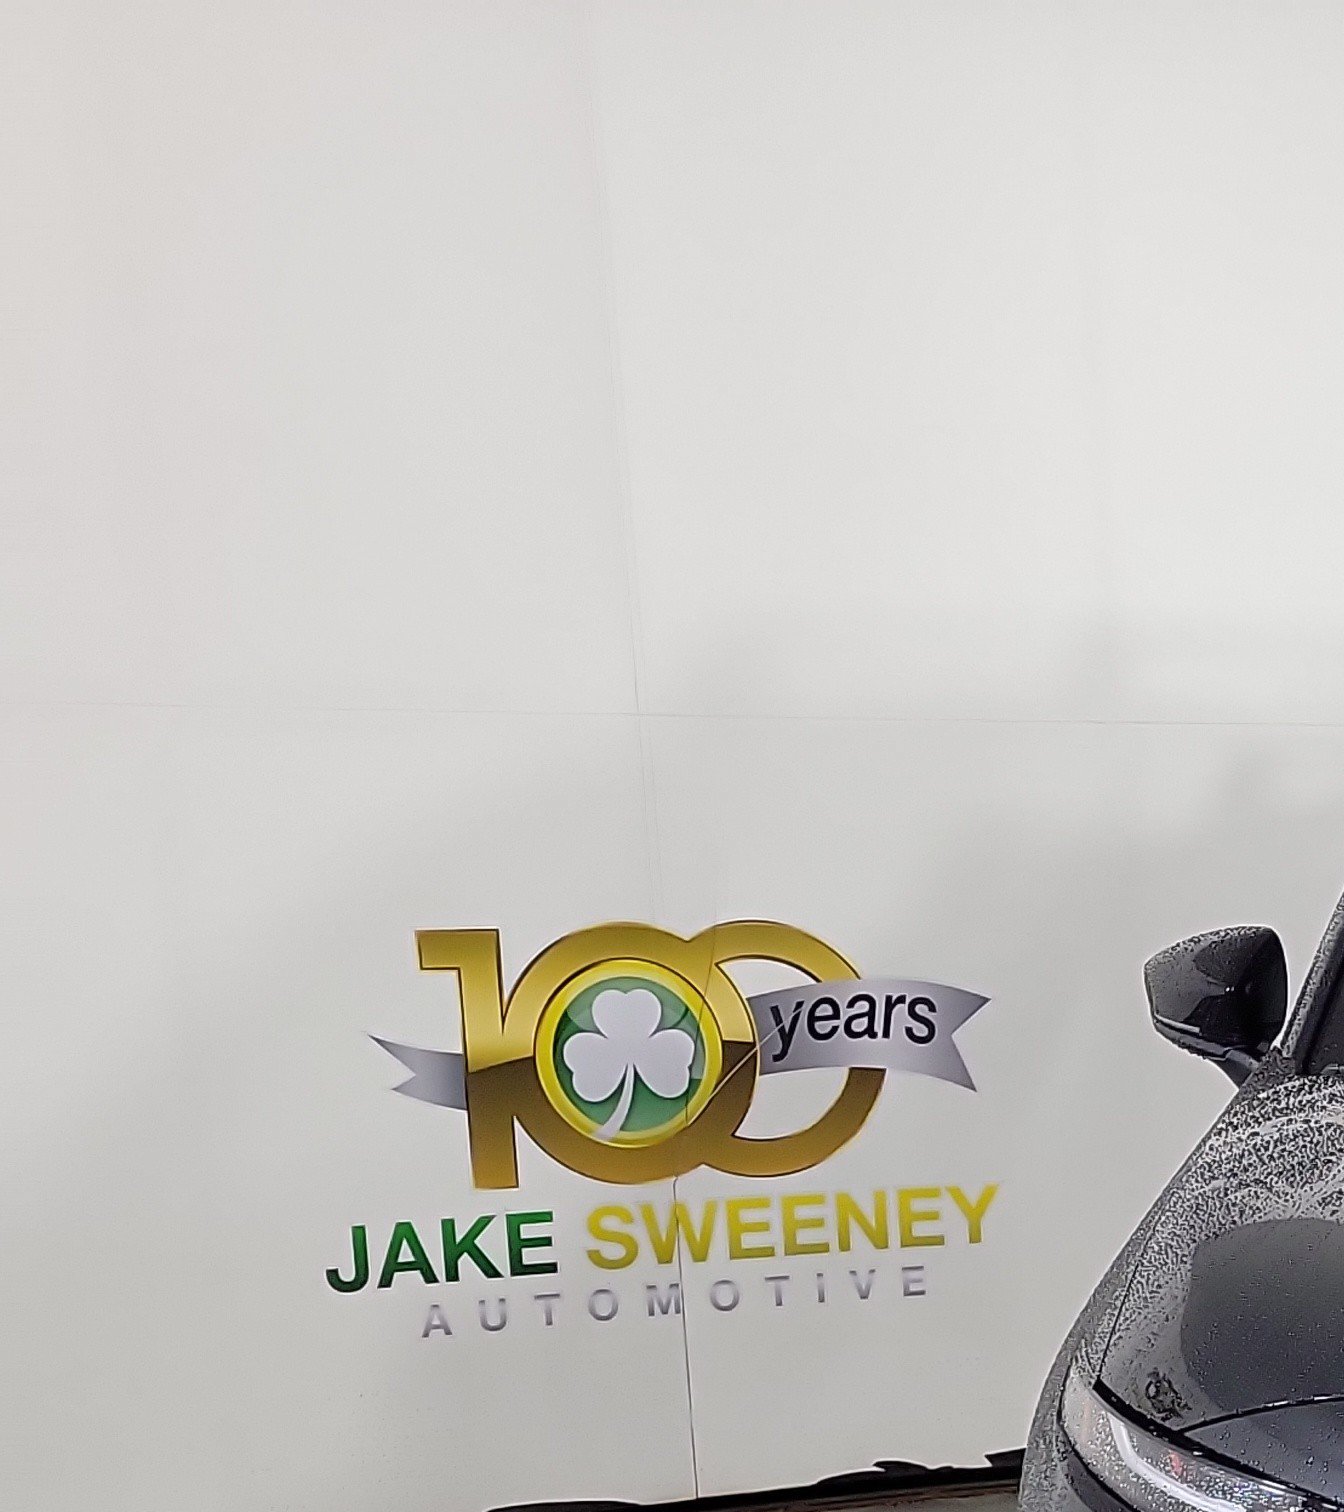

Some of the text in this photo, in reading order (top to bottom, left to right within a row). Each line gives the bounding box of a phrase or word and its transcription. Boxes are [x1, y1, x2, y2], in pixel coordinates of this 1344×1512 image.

[415, 920, 938, 1189] 100 years
[325, 1183, 999, 1294] JAKE SWEENEY
[421, 1264, 928, 1338] AUTOMOTIVE
